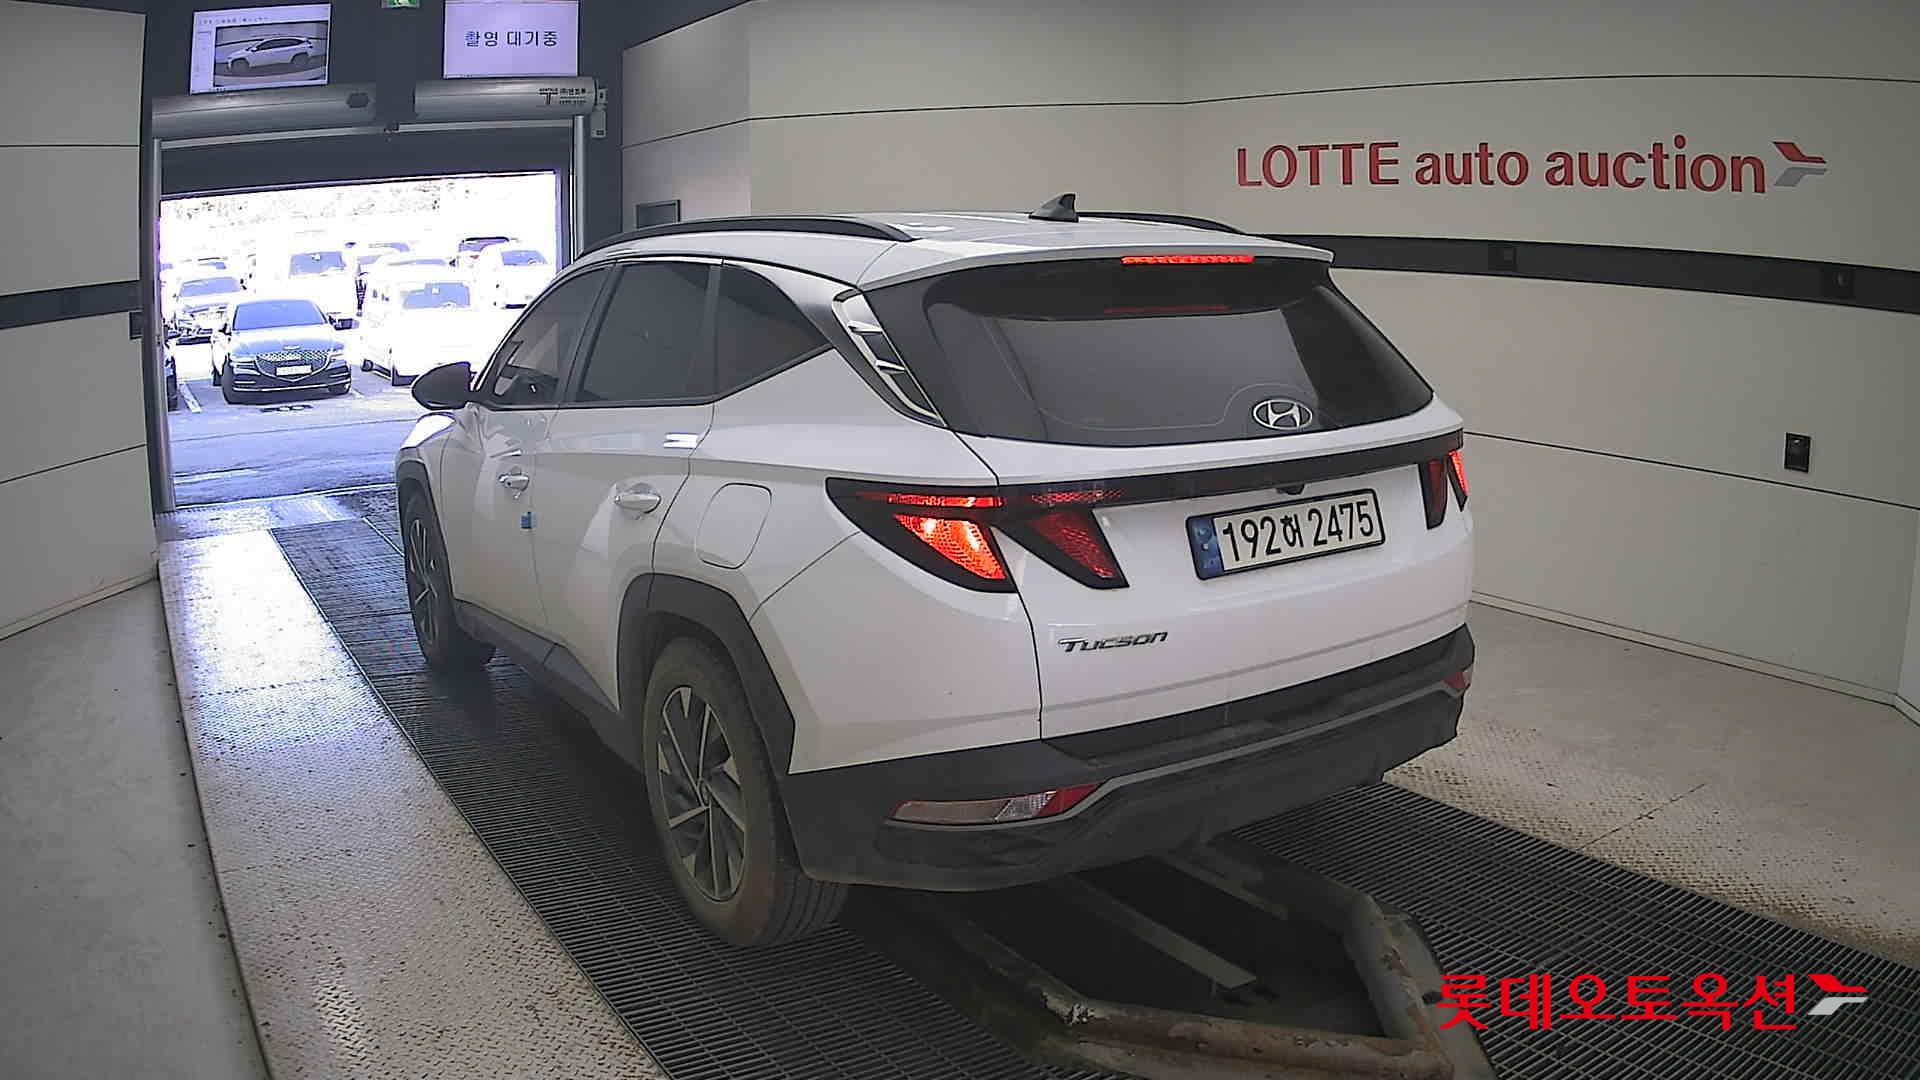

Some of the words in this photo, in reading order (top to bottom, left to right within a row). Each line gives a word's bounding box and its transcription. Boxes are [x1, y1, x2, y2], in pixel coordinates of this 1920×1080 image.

[465, 31, 498, 47] 촬영
[506, 31, 558, 47] 대기중
[1237, 142, 1399, 187] LOTTE
[1415, 142, 1529, 186] auto
[1544, 134, 1767, 194] auction
[1223, 514, 1304, 562] 192허
[1307, 500, 1374, 547] 2475
